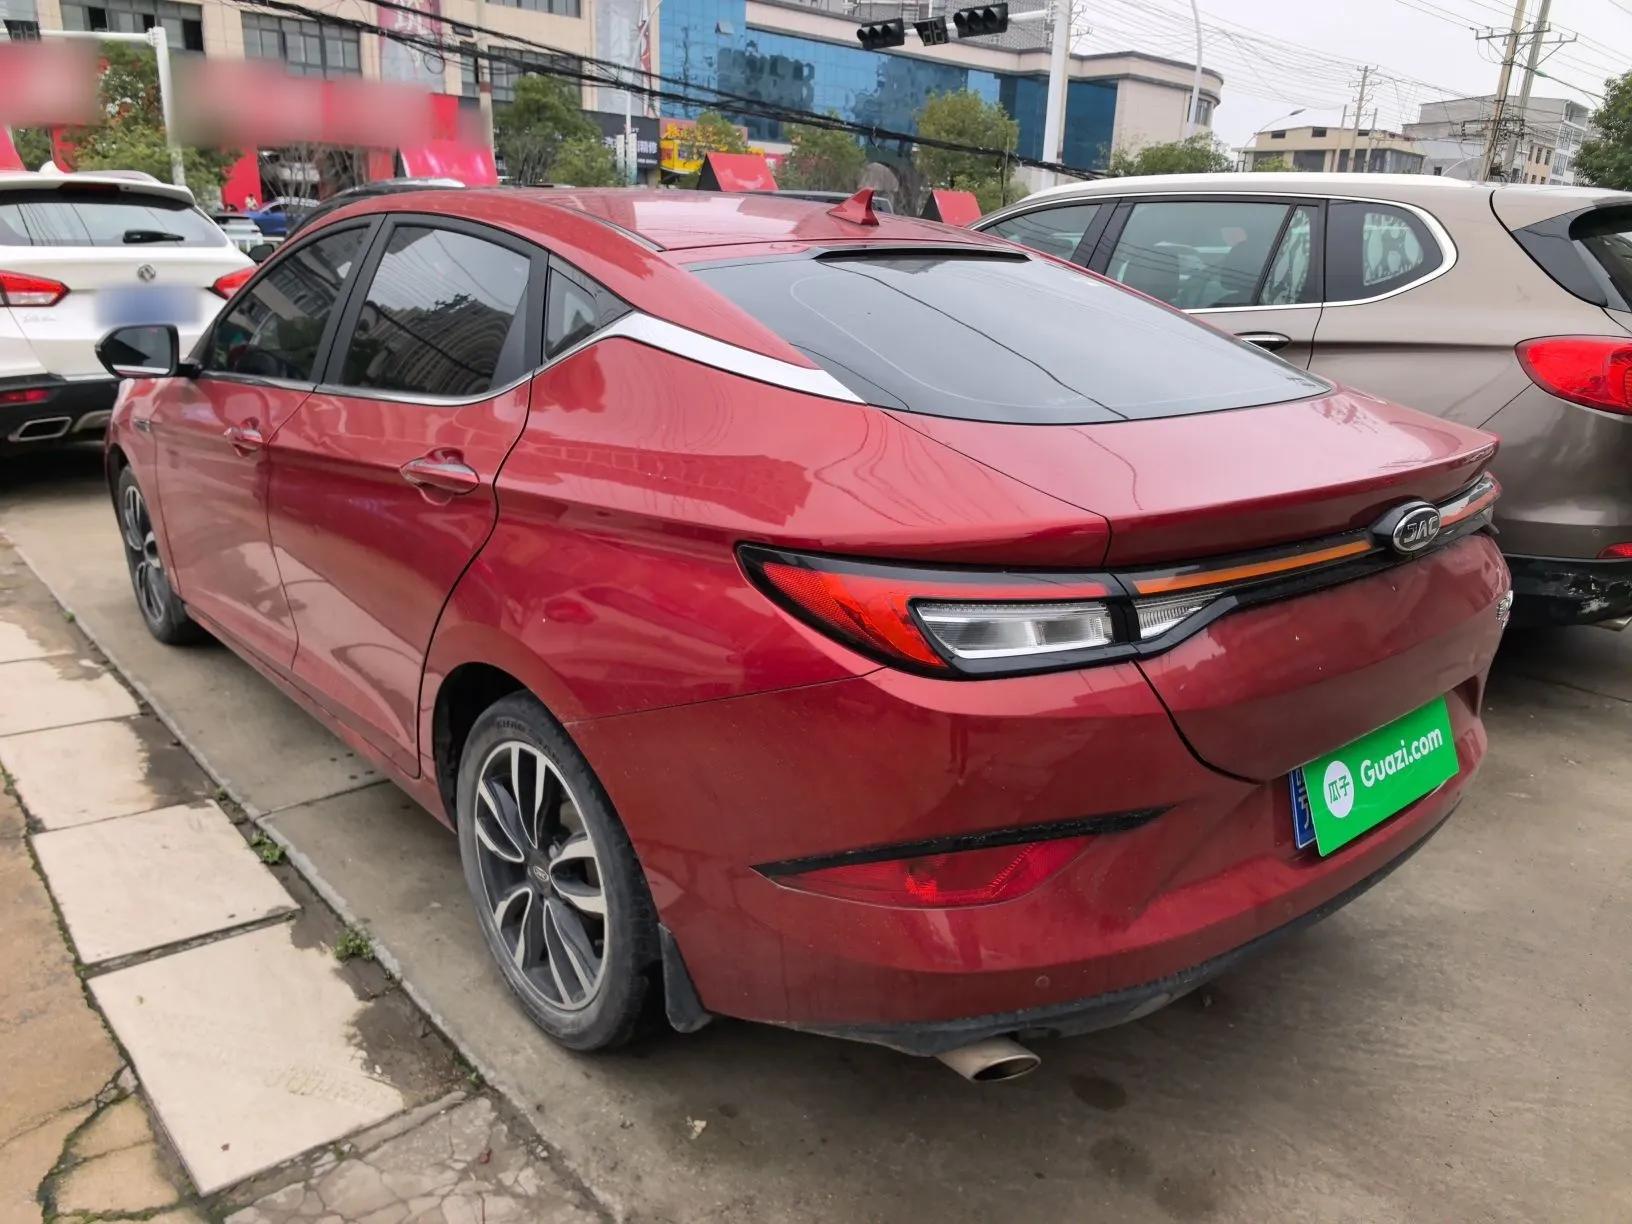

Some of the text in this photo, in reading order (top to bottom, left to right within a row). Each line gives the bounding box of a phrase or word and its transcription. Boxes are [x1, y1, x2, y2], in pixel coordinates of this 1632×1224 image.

[1403, 515, 1439, 543] JAC
[1328, 776, 1350, 804] 瓜子
[1360, 728, 1443, 788] Guazi.com
